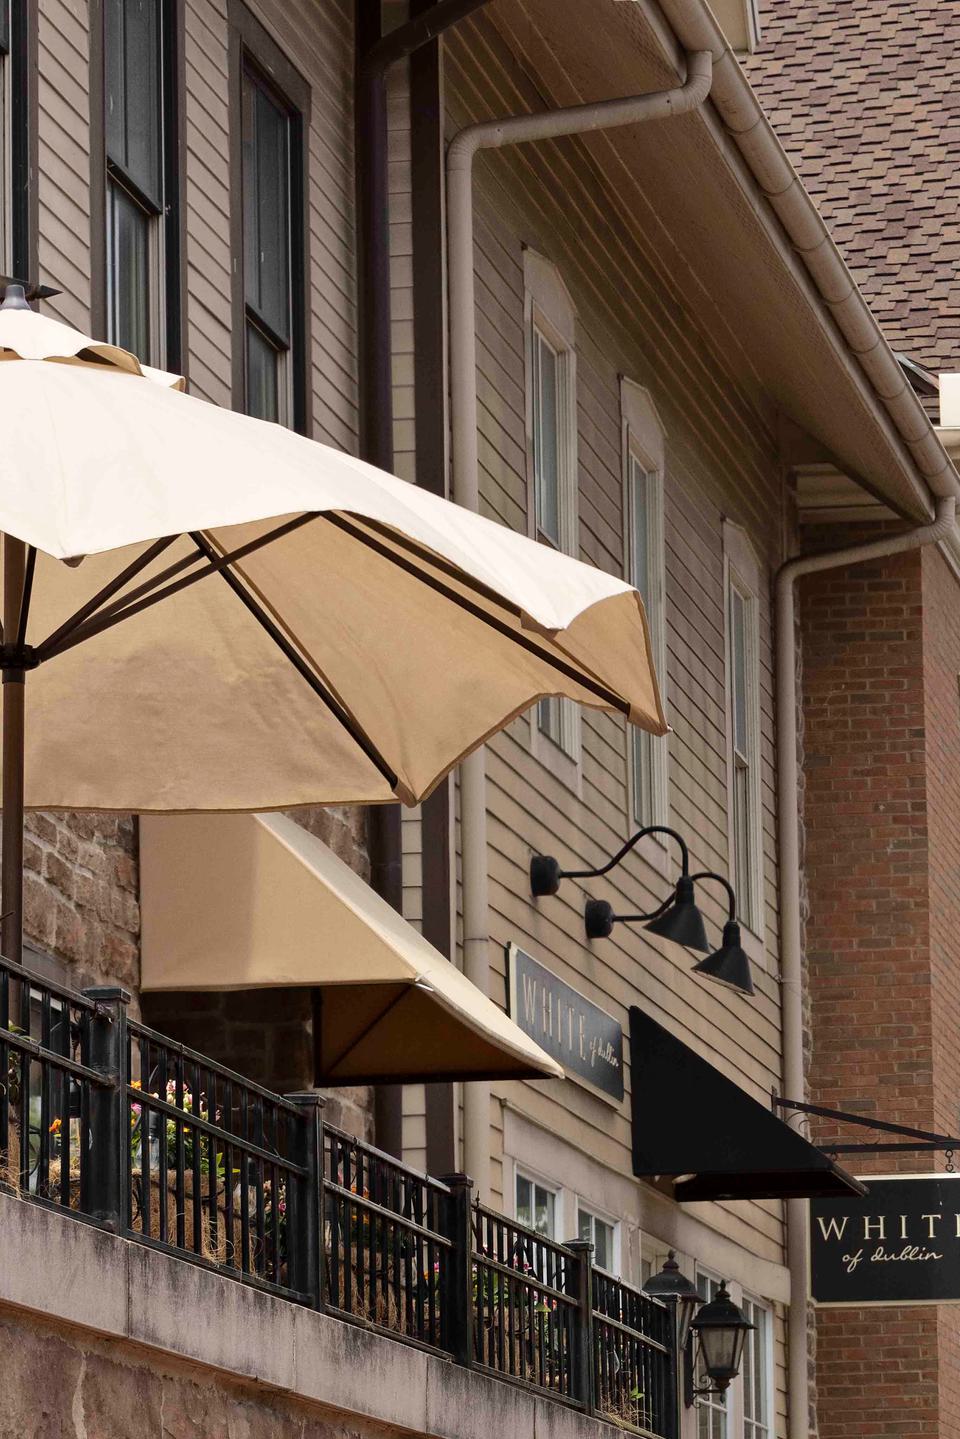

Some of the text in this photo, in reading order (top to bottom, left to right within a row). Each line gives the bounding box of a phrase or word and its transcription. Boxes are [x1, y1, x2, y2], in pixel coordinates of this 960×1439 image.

[522, 973, 586, 1061] WHITE
[842, 1245, 943, 1273] of dublin
